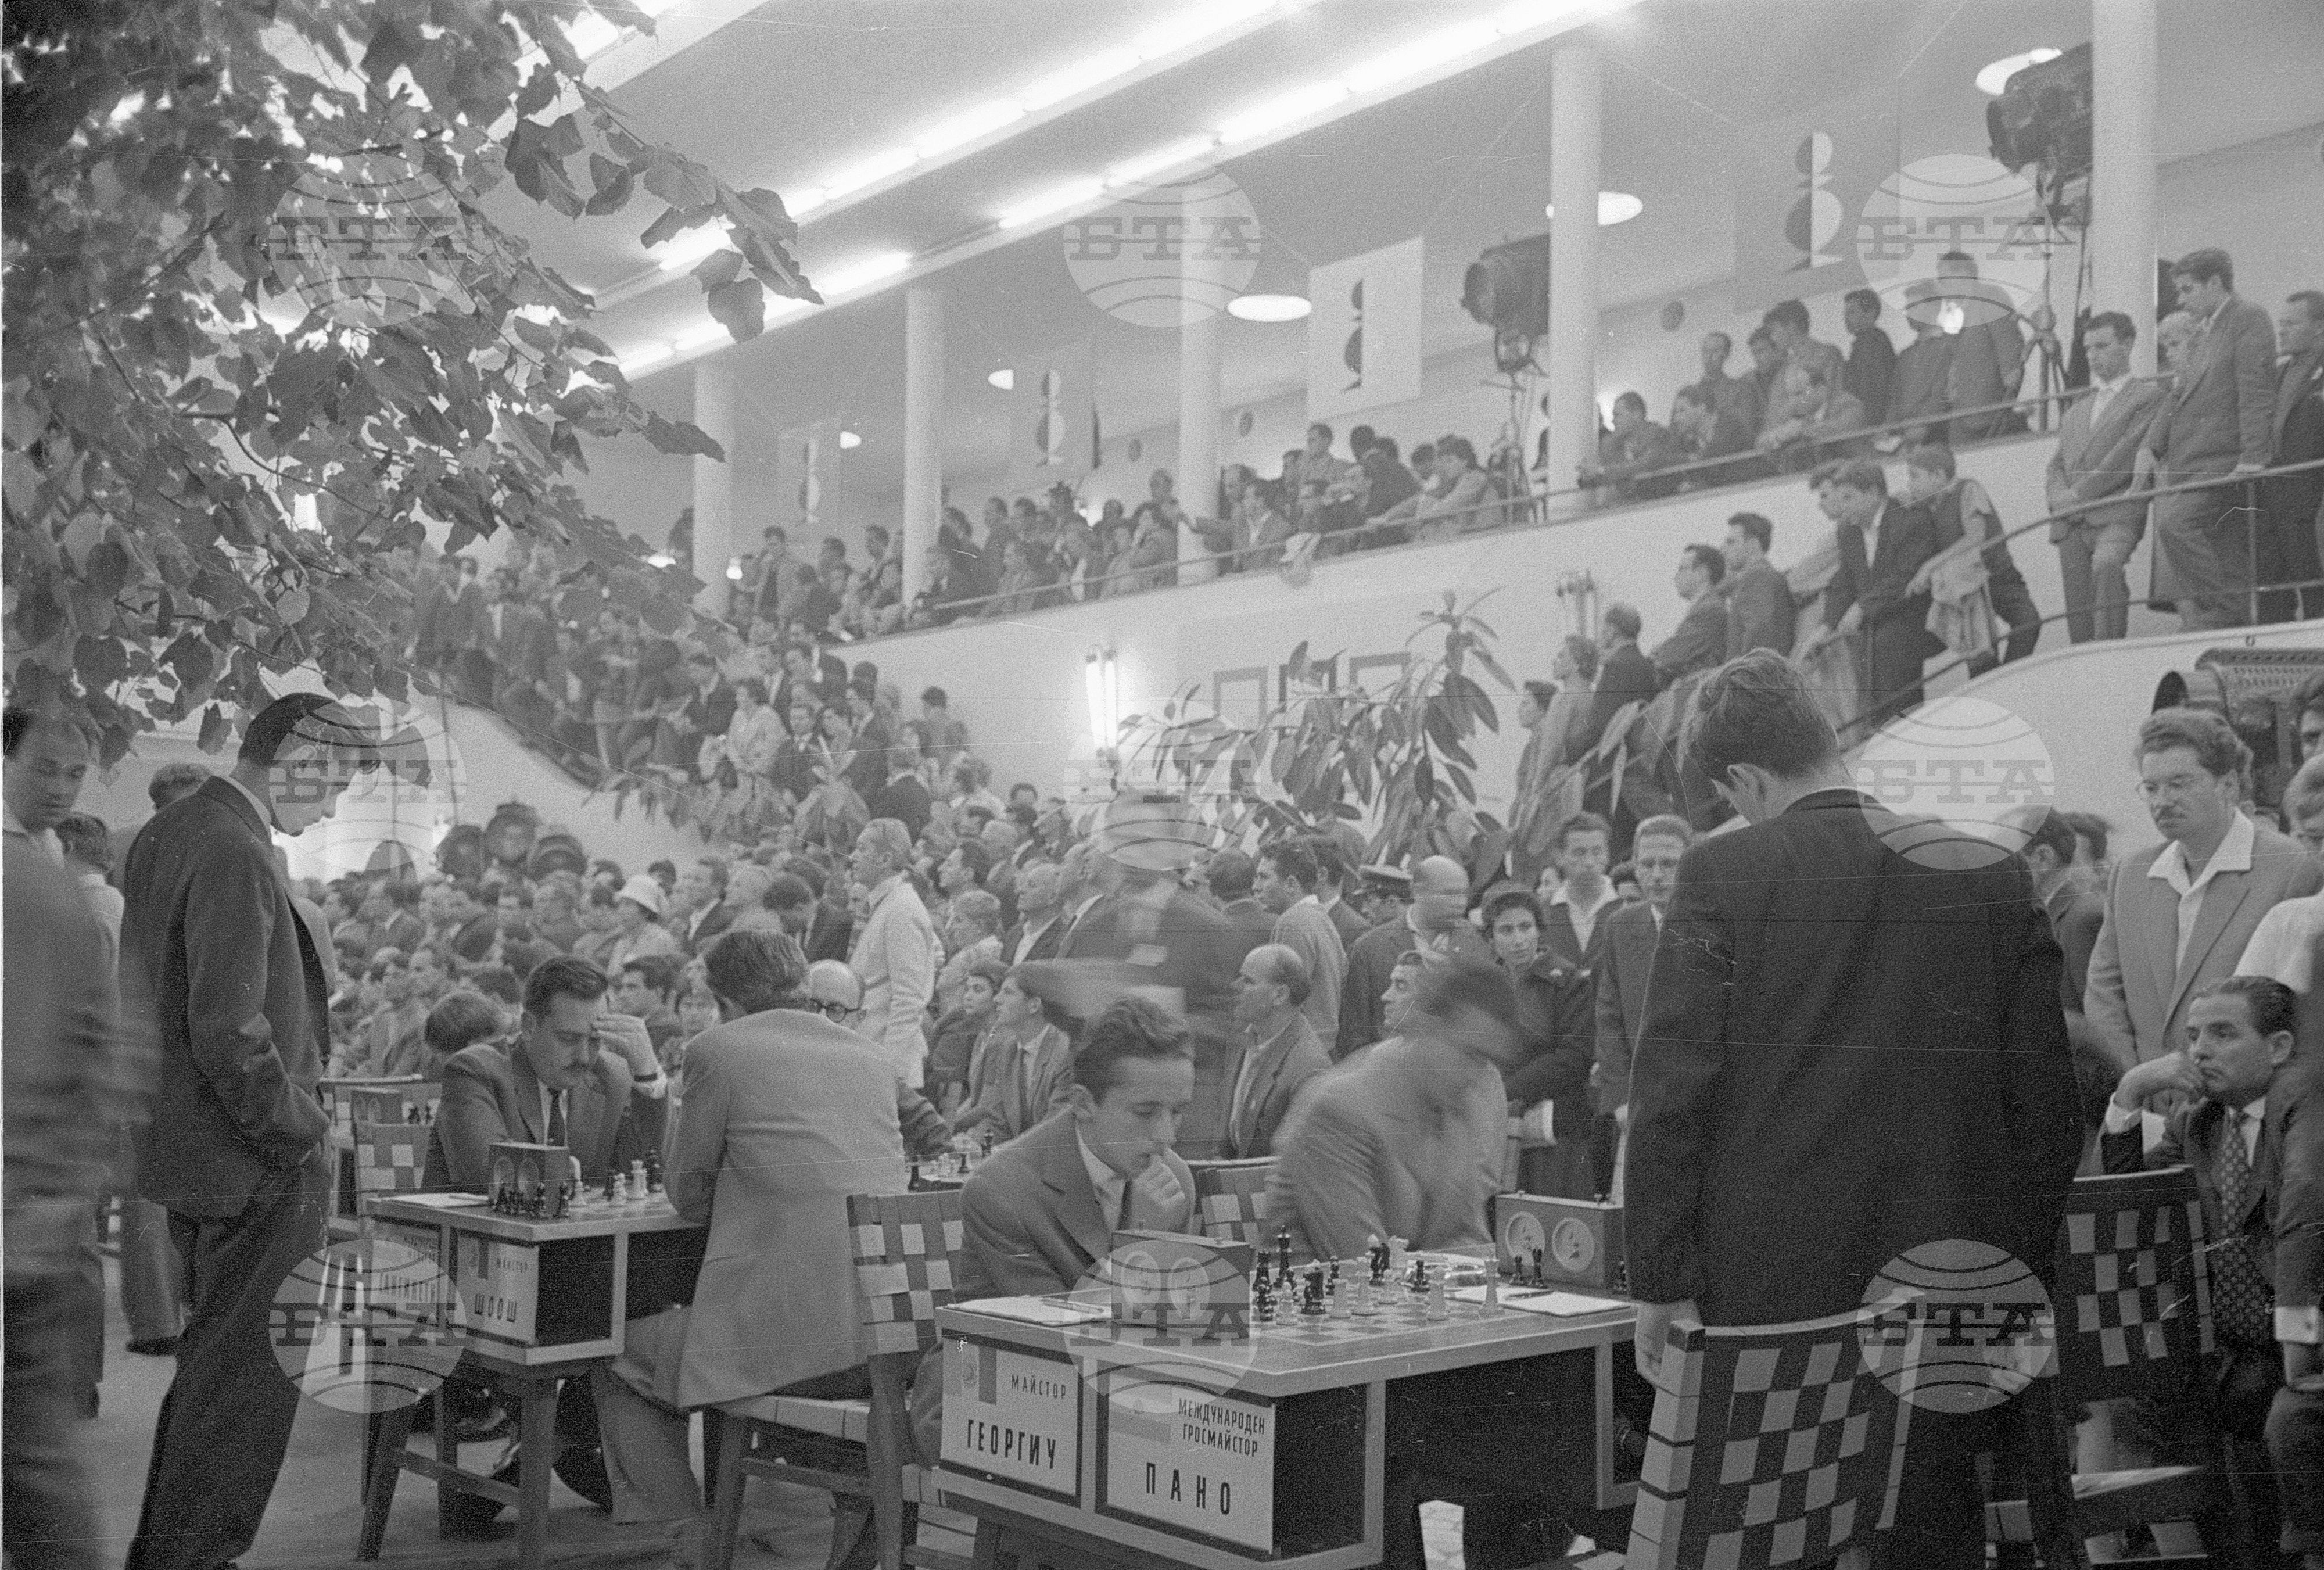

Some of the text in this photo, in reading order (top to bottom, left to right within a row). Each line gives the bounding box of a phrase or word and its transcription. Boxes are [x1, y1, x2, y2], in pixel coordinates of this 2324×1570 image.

[1010, 1374, 1067, 1400] МАЙСТОР
[1178, 1398, 1265, 1435] МЕЖДУНАРОДЕН
[1183, 1423, 1258, 1457] ГРОСМАЙСТОР
[1146, 1461, 1231, 1515] ПАНО
